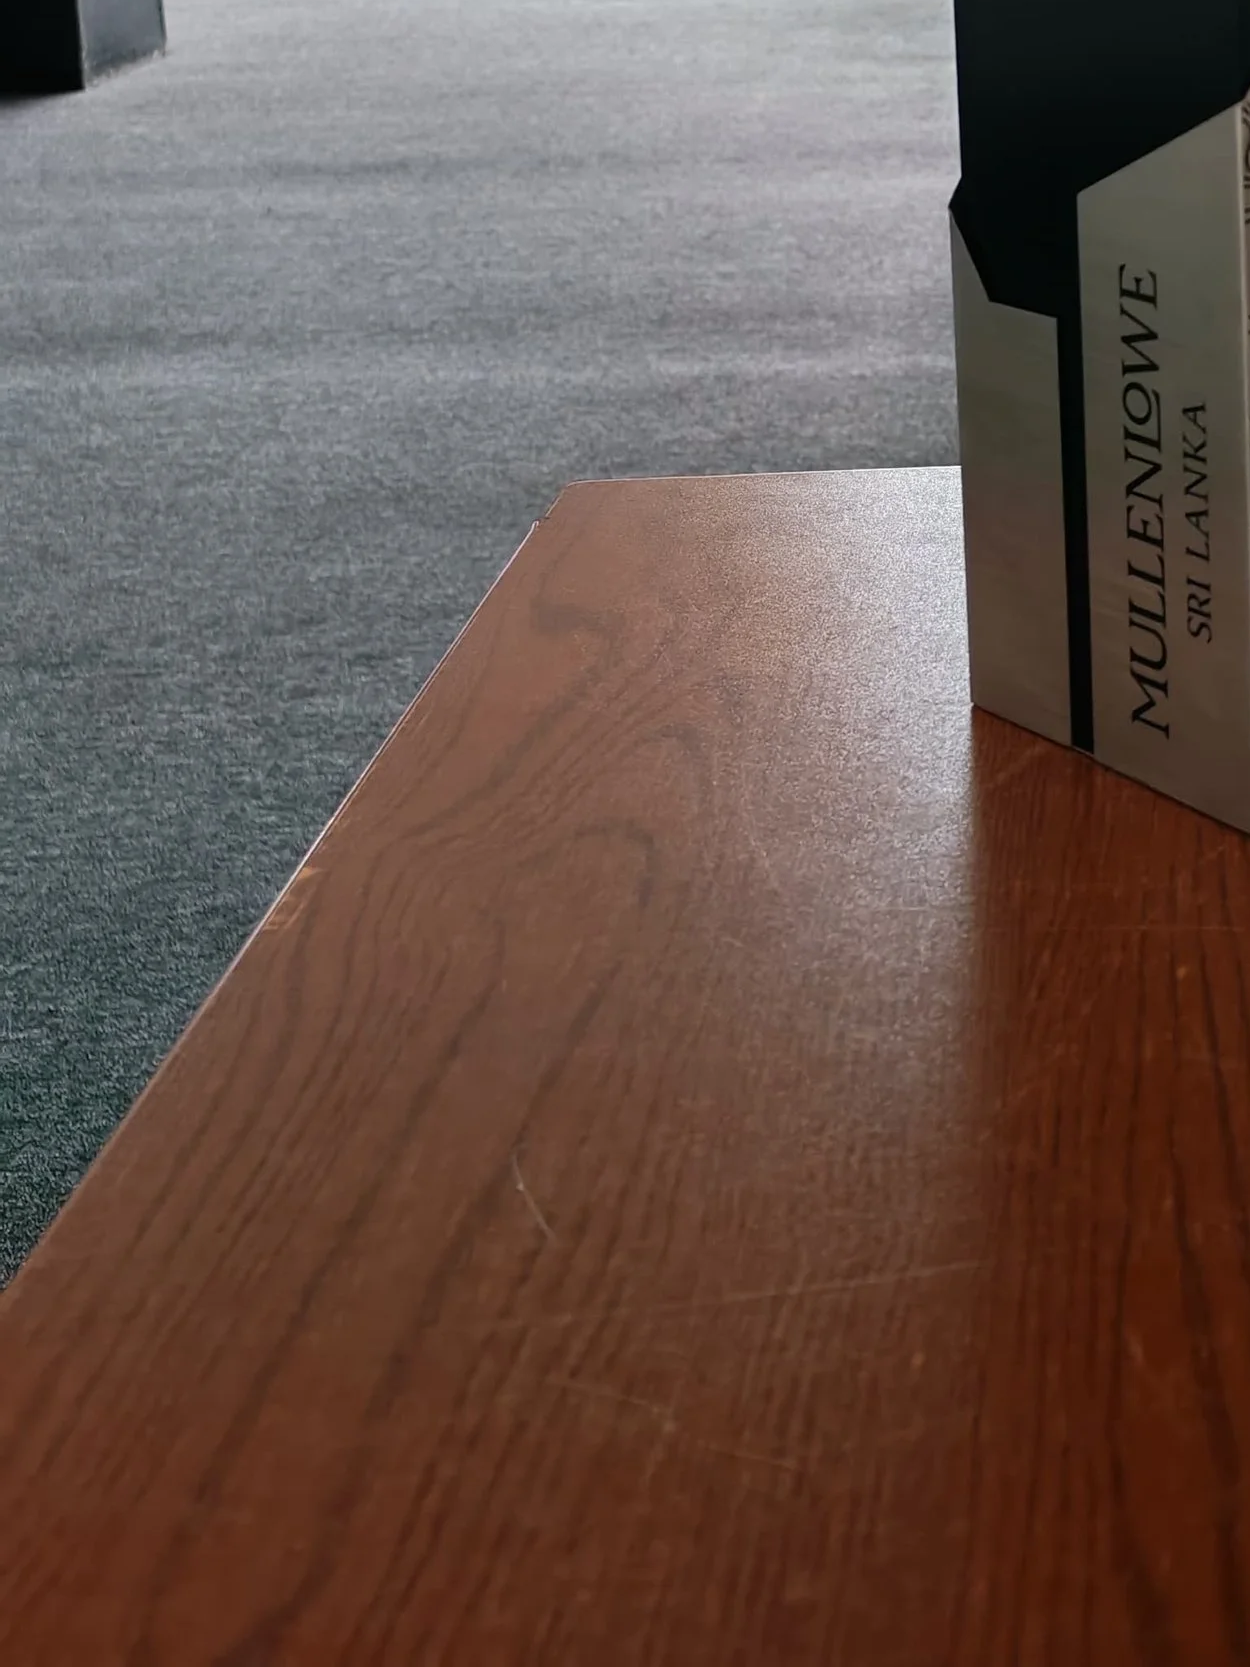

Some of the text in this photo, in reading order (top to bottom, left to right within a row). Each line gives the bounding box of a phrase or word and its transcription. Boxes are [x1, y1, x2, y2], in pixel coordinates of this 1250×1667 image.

[1119, 263, 1170, 741] MULLENLOWE
[1181, 401, 1213, 645] SRI LANKA
